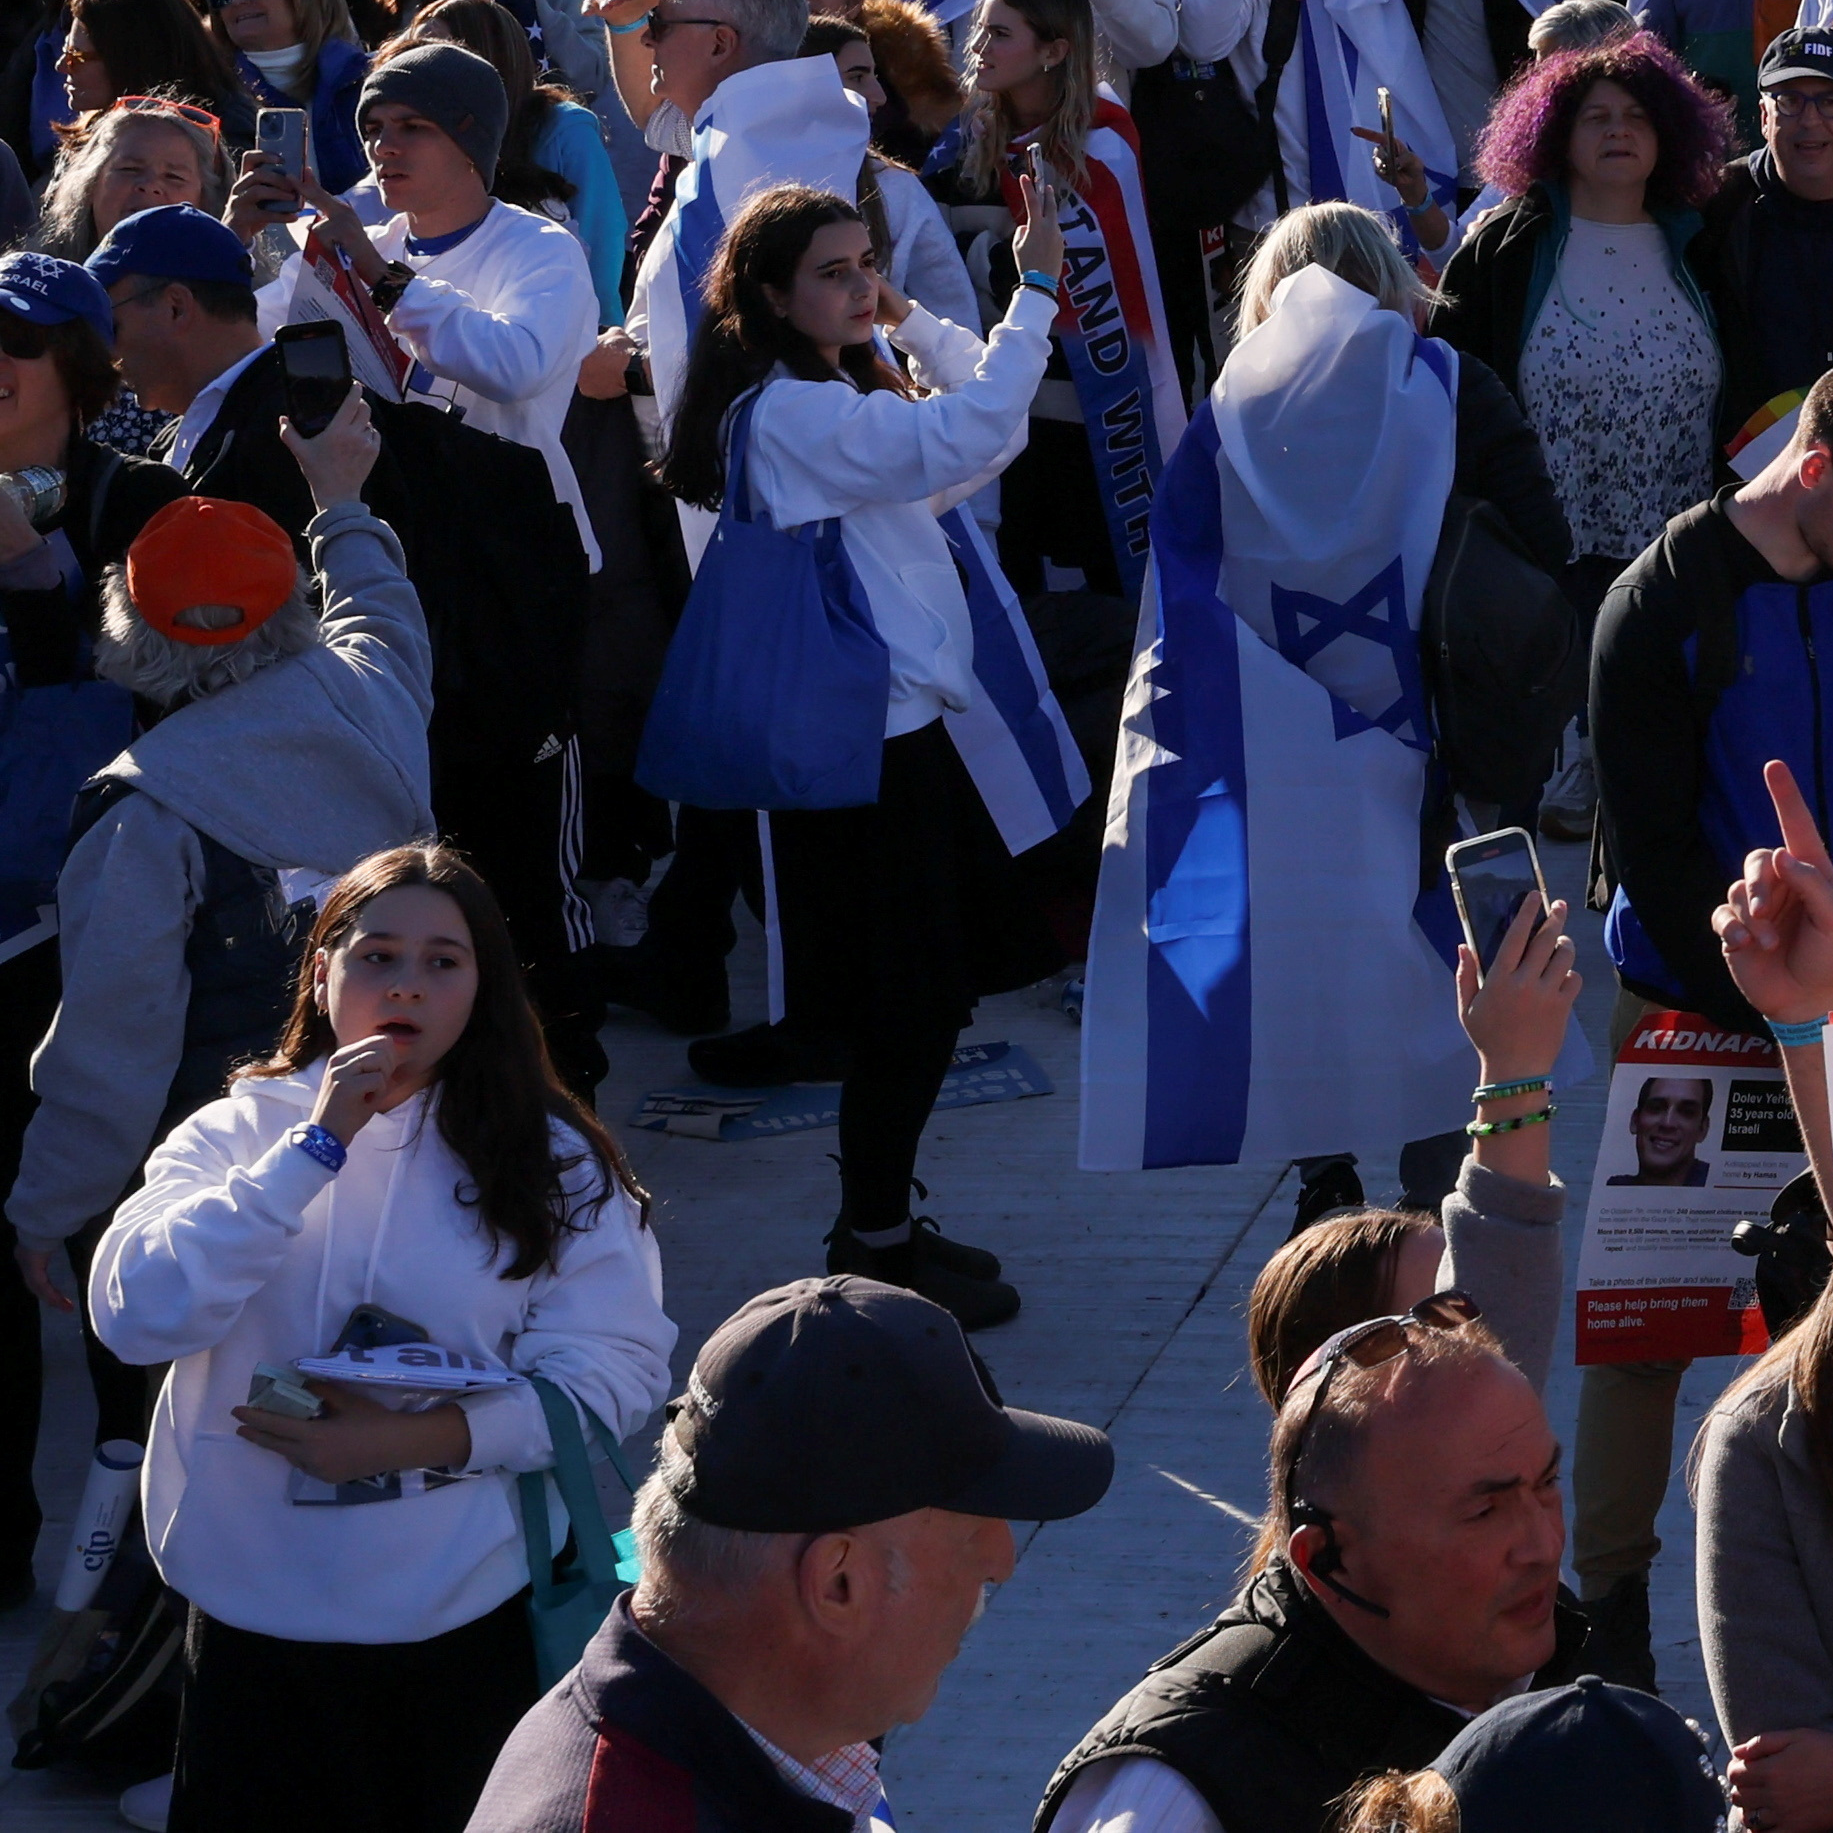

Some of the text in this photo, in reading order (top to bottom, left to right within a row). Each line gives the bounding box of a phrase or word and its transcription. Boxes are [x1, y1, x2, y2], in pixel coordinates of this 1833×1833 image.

[1804, 42, 1833, 58] FIDF
[1730, 1107, 1794, 1122] 35 years old
[1727, 1122, 1760, 1135] Israeli
[1587, 1296, 1708, 1313] Please help bring them
[1587, 1316, 1646, 1329] home alive.
